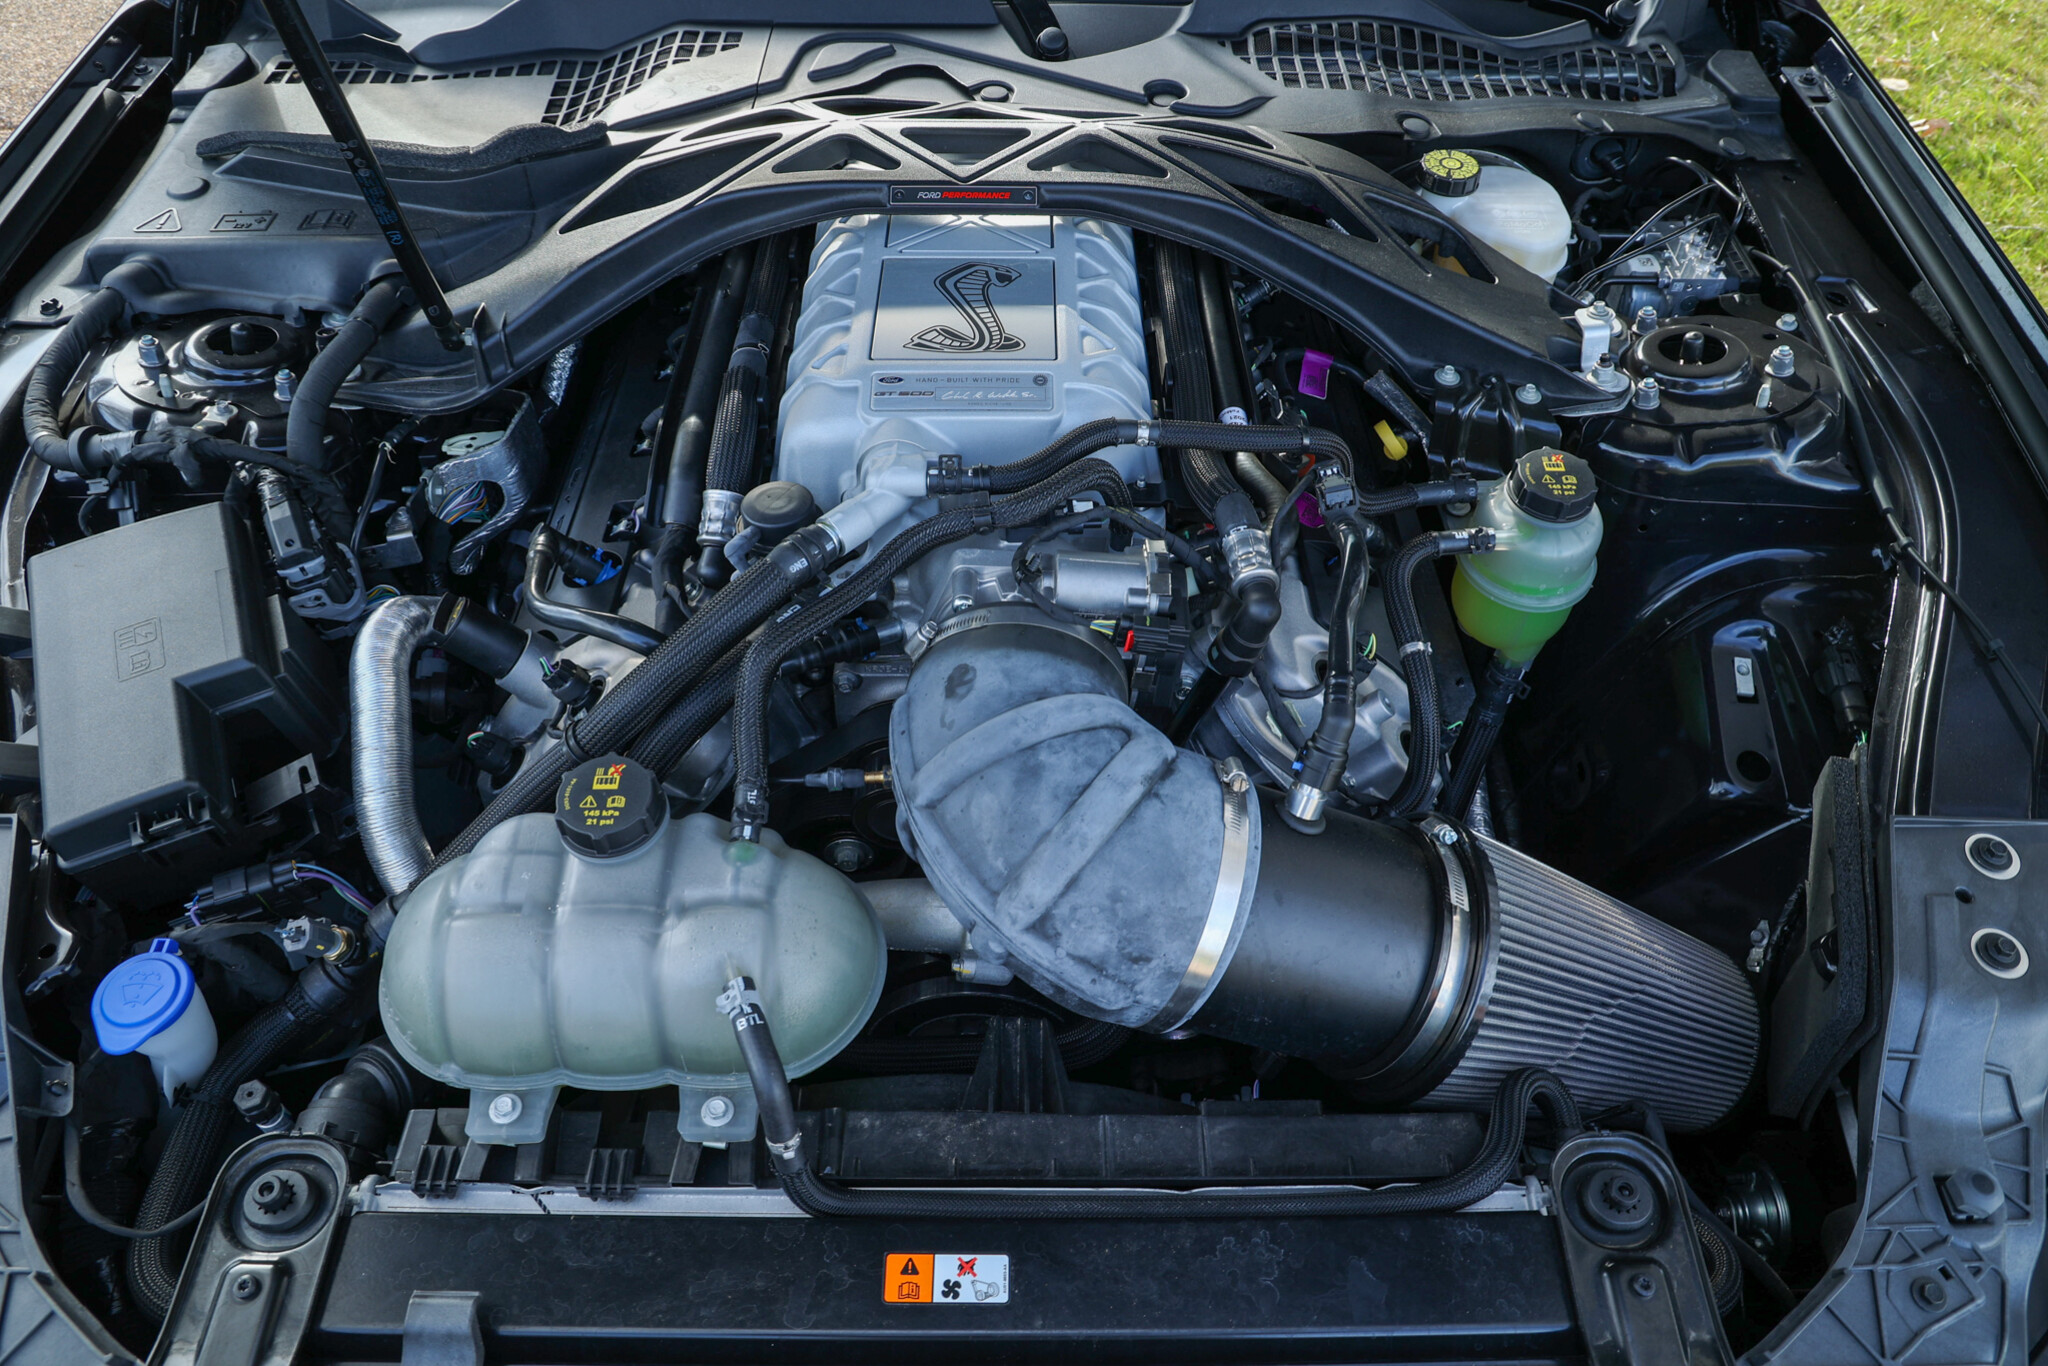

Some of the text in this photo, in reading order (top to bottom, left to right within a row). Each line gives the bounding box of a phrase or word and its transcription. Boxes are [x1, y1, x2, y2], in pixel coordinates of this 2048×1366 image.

[917, 191, 1012, 199] FORD PERFORMANCE
[789, 557, 809, 574] ENG
[601, 809, 620, 817] kPa
[585, 818, 615, 827] 21 psi
[736, 1012, 765, 1032] BTL
